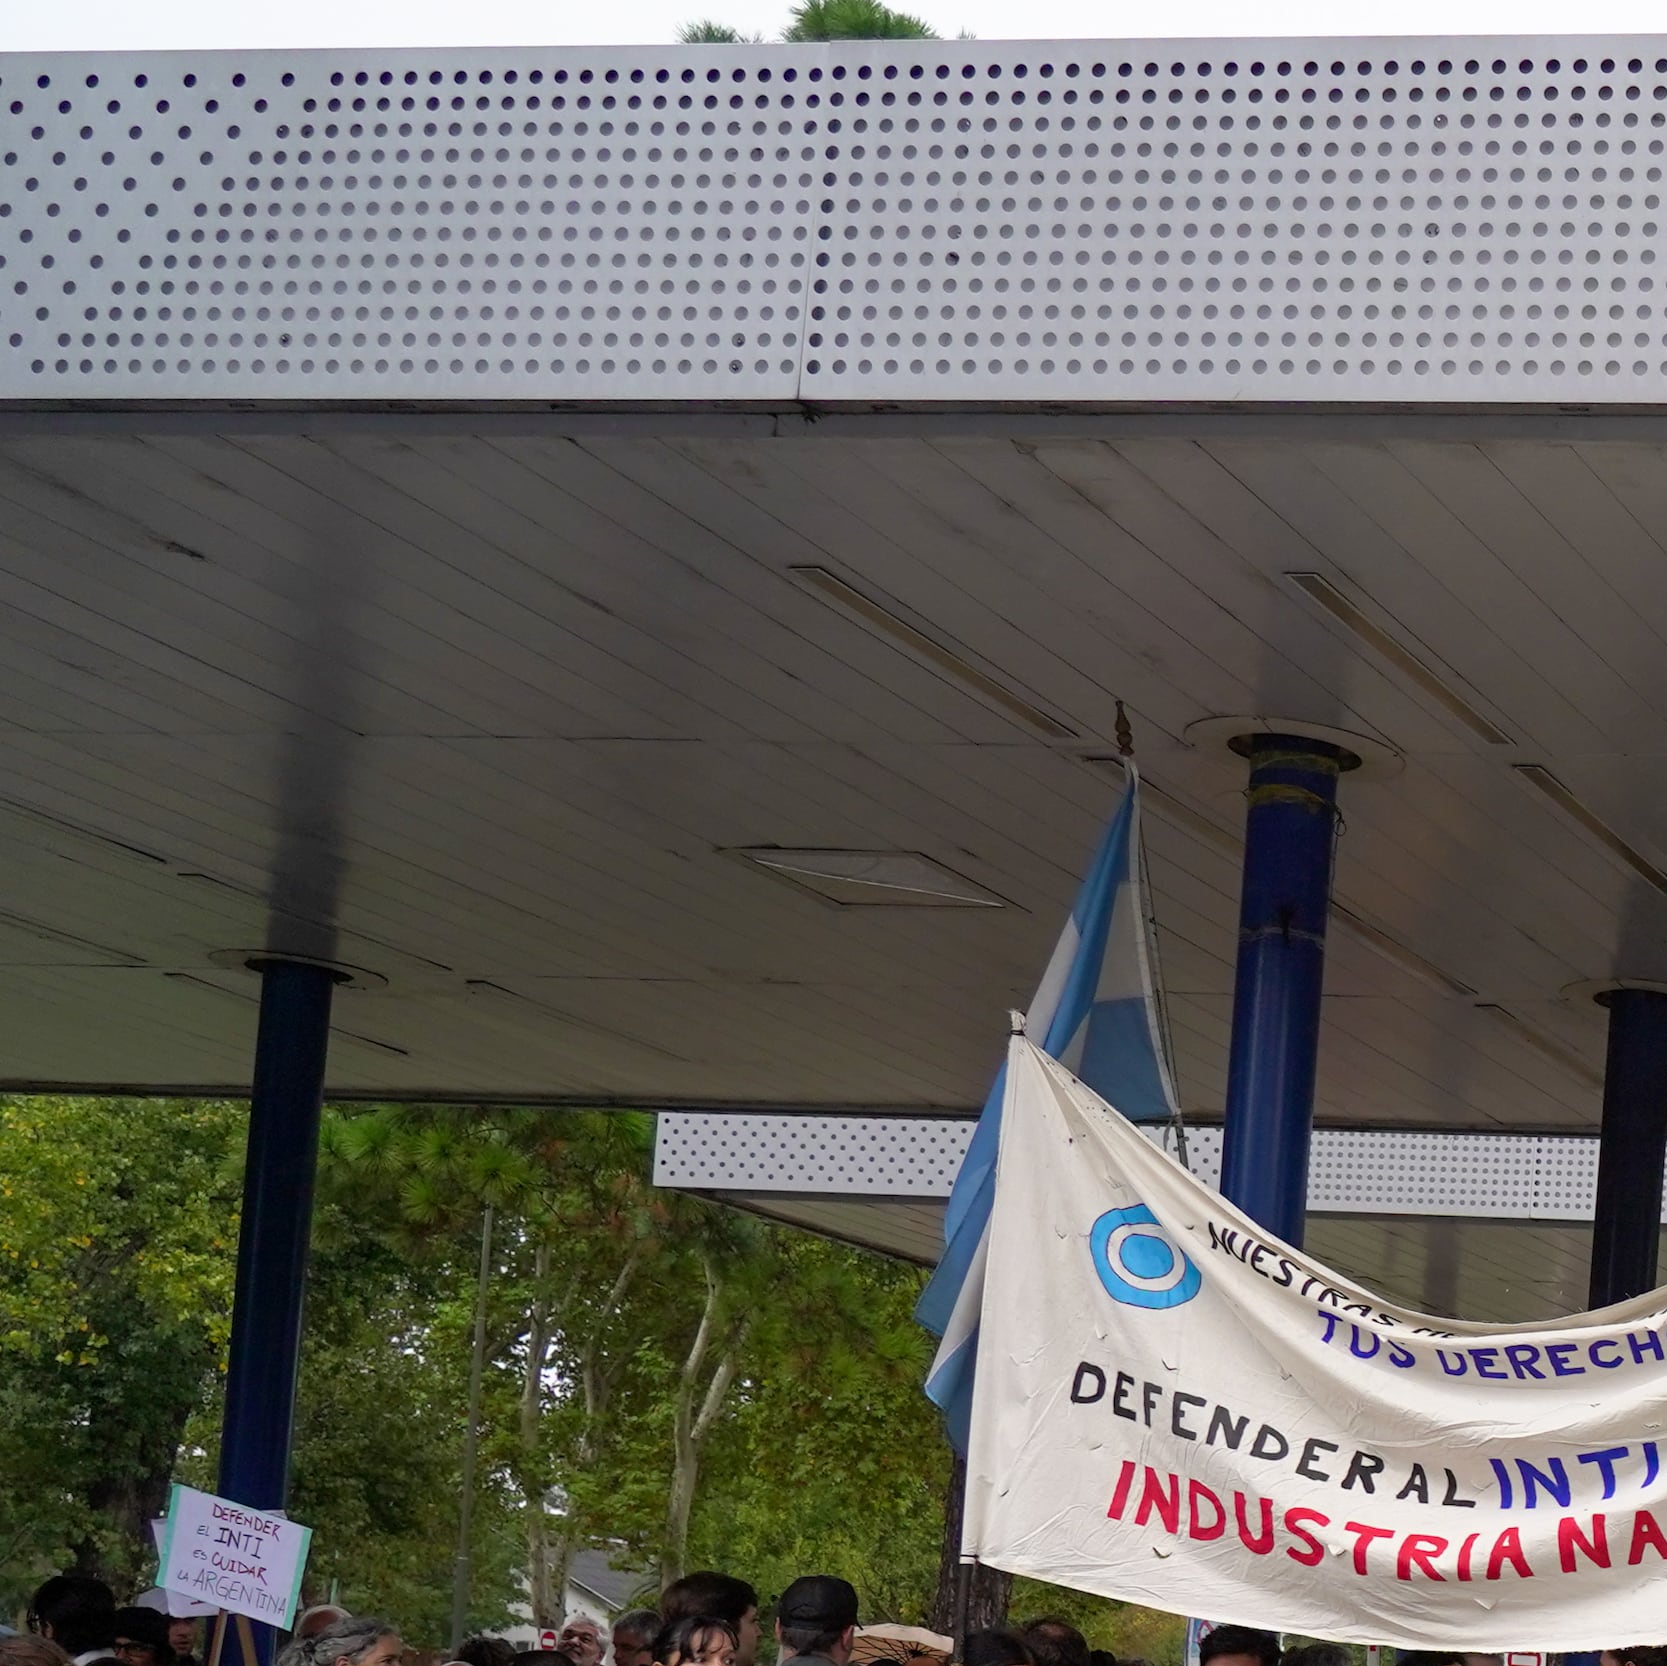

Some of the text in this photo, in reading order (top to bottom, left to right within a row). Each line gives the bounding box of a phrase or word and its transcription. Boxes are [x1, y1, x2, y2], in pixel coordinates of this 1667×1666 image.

[1208, 1221, 1402, 1327] NUESTRAS
[1317, 1310, 1416, 1368] TUS
[1070, 1361, 1385, 1494] DEFENDER
[1397, 1463, 1476, 1508] AL
[1489, 1442, 1659, 1511] INTI
[212, 1503, 282, 1542] DEFENDER
[213, 1527, 264, 1559] INTI
[1107, 1460, 1538, 1583] INDUSTRIA
[177, 1568, 287, 1617] LA ARGENTINA
[211, 1551, 268, 1586] CUIDAR
